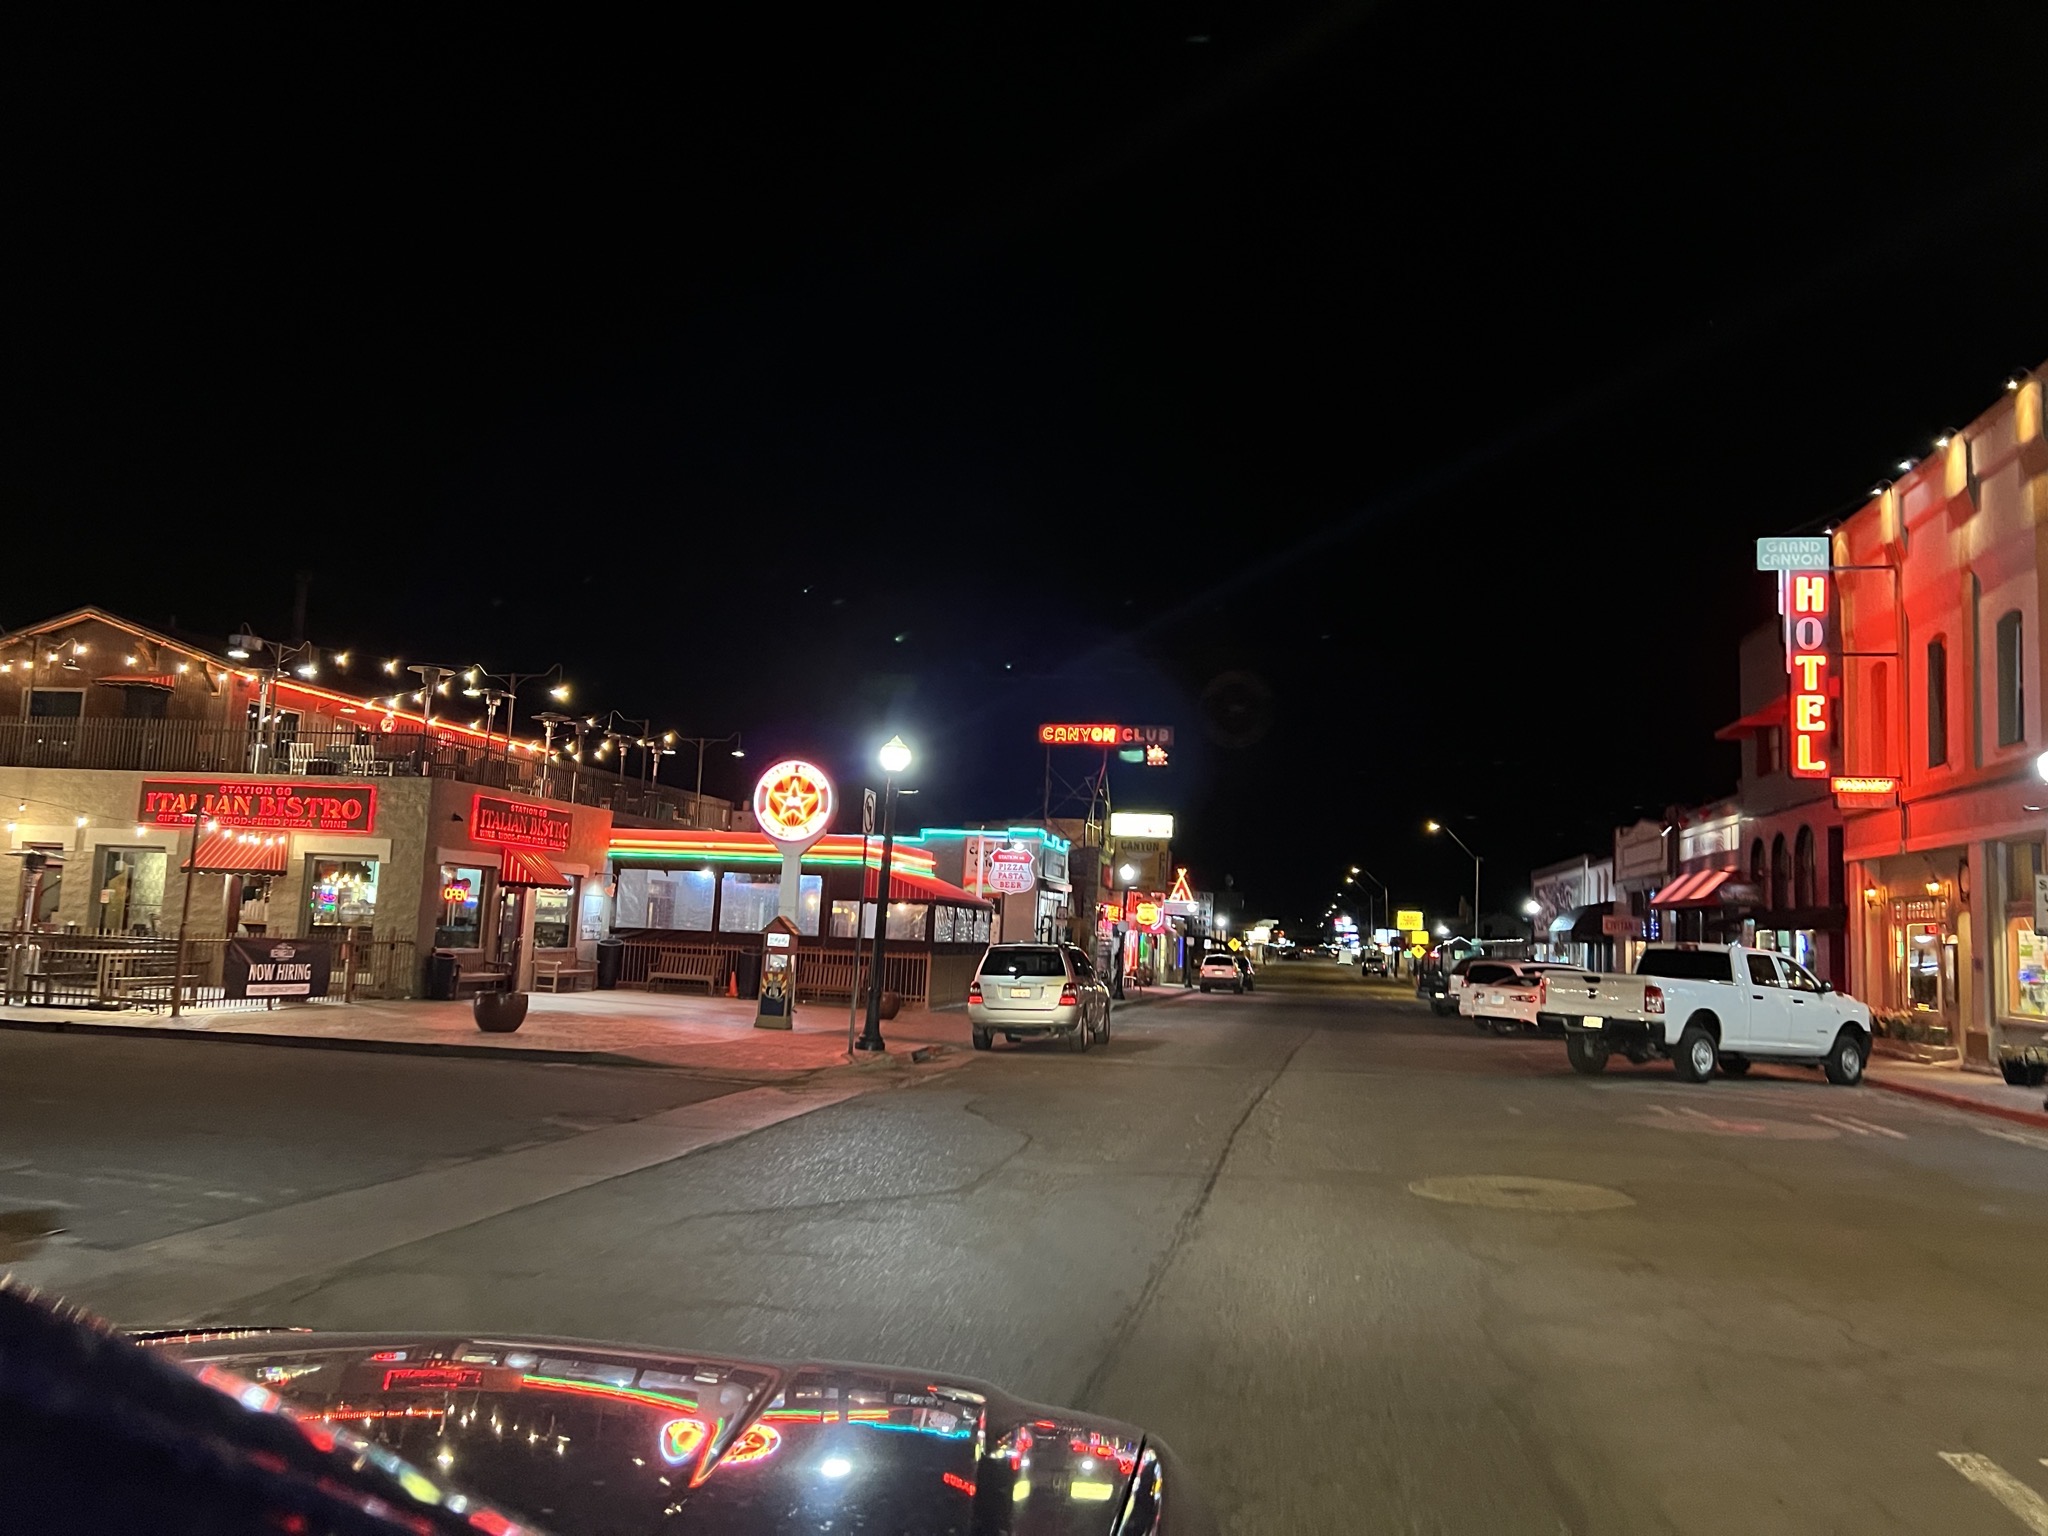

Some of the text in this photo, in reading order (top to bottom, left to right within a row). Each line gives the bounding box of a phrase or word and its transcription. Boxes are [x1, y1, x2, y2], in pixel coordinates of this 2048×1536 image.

[1766, 541, 1821, 553] GRAND
[1761, 554, 1824, 566] CANYON
[1795, 576, 1827, 770] HOTEL
[1042, 726, 1169, 742] CANYON CLUB
[219, 785, 273, 796] STATION
[258, 796, 363, 820] BISTRO
[510, 804, 537, 817] STATION
[156, 814, 180, 823] GIFT
[181, 815, 210, 824] SHP
[282, 818, 313, 828] PIZZA
[319, 820, 348, 829] WINE
[479, 809, 570, 840] ITALIAN BISTRO
[1120, 841, 1160, 852] CANYON
[998, 863, 1025, 871] PIZZA
[997, 872, 1025, 880] PASTA
[999, 881, 1022, 889] BEER
[444, 888, 468, 902] OPEN
[248, 963, 312, 981] NOW HIRING
